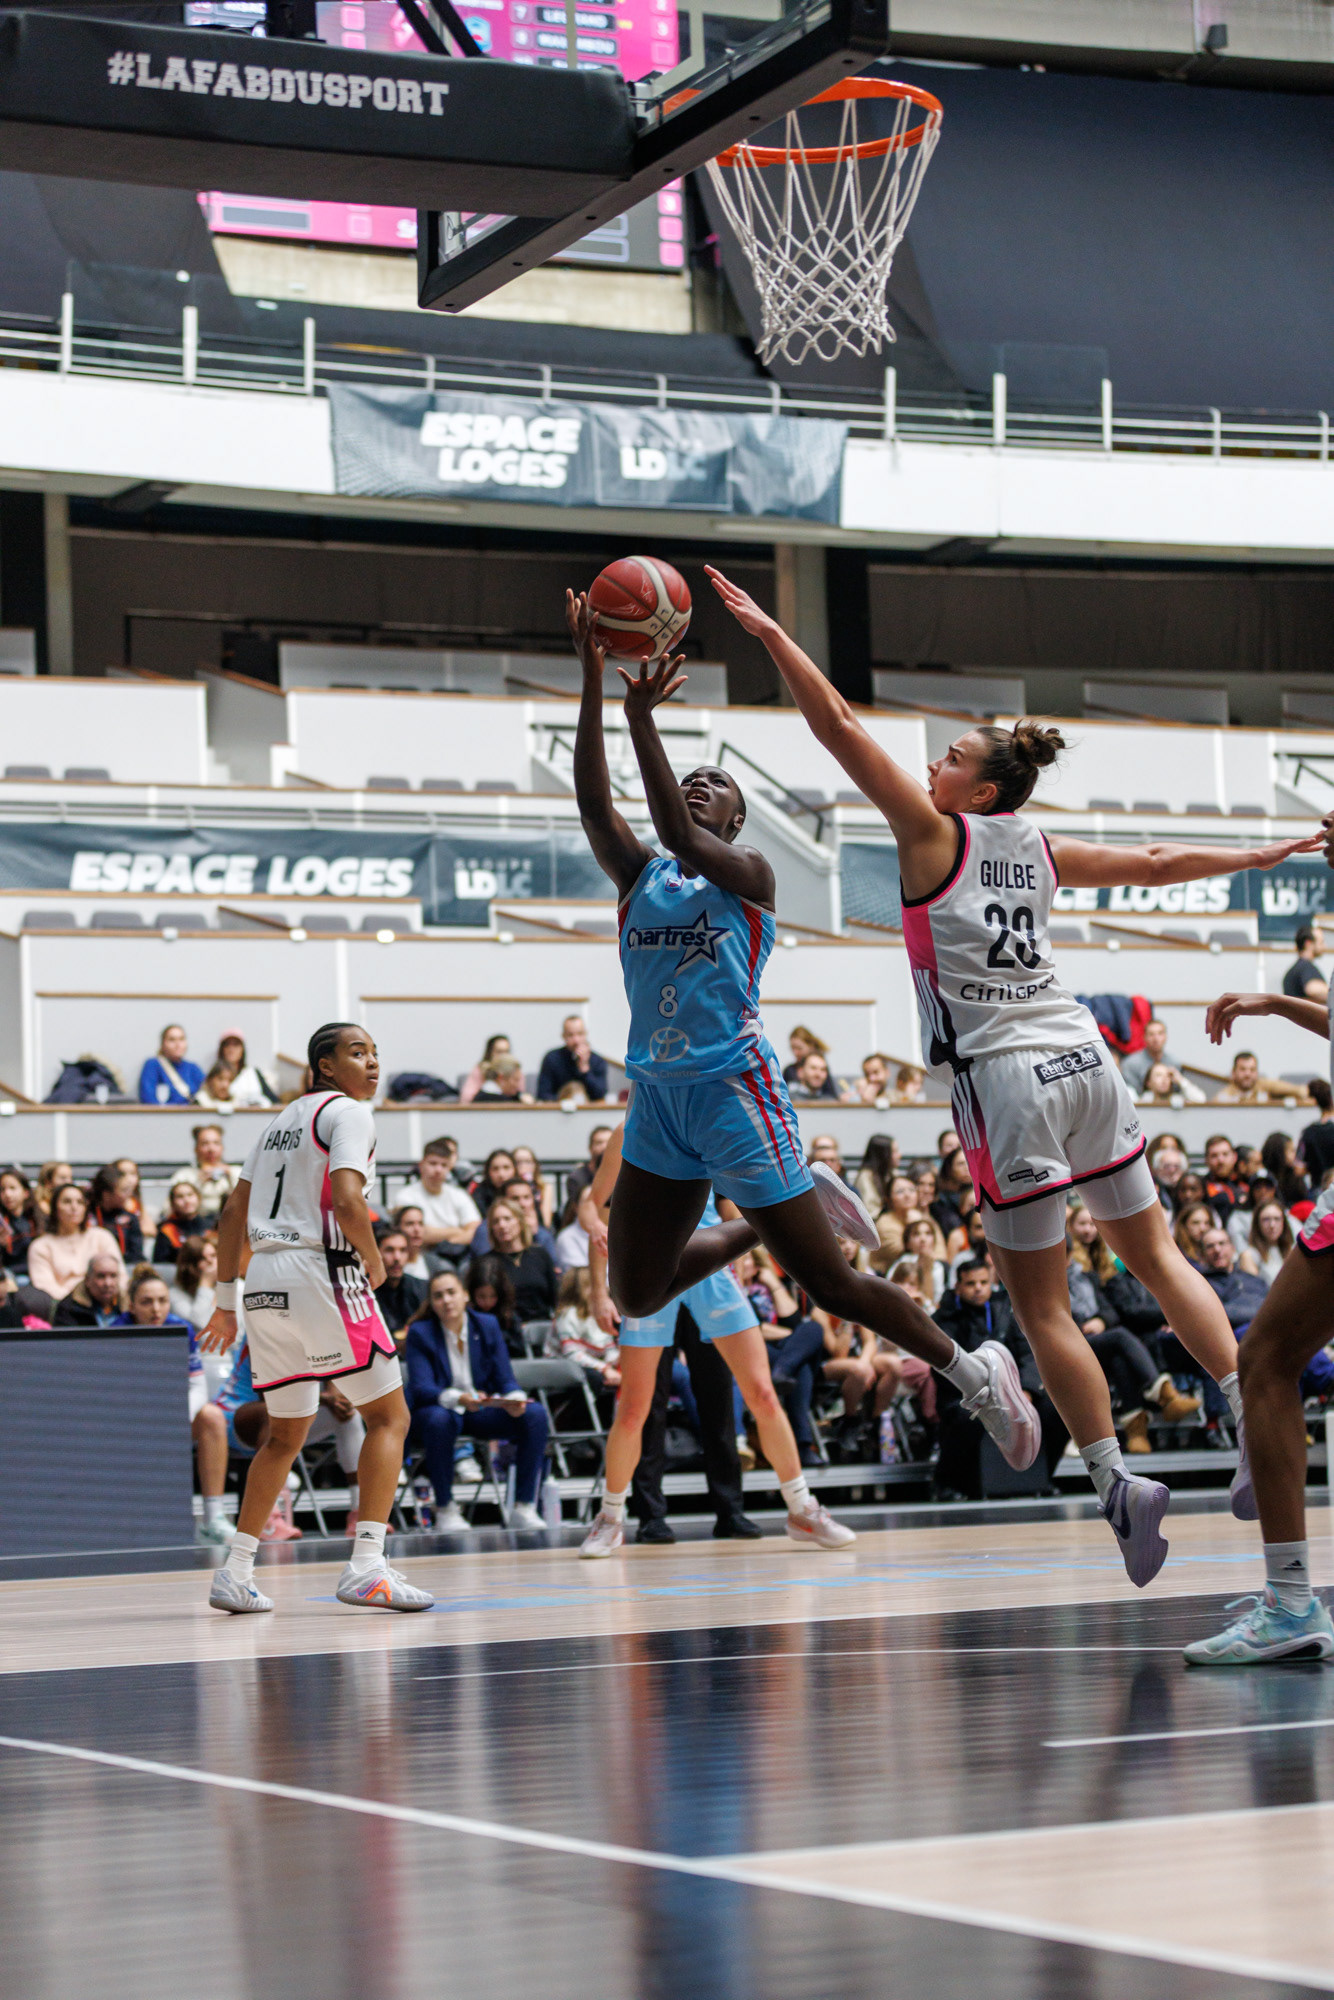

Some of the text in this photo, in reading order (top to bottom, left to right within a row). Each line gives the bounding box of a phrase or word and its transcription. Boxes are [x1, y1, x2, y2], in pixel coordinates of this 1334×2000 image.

[107, 51, 449, 116] #LAFABDUSPORT
[420, 411, 582, 454] ESPACE
[438, 448, 569, 488] LOGES
[69, 852, 415, 898] ESPACE LOGES
[455, 869, 532, 899] LDLC
[981, 860, 1036, 890] GULBE
[1108, 877, 1231, 913] LOGES
[1262, 887, 1326, 916] LDLC
[627, 926, 707, 949] Chartres
[984, 903, 1041, 969] 23
[658, 984, 678, 1018] 8
[1072, 1051, 1096, 1068] CAR
[269, 1164, 286, 1219] 1
[269, 1296, 285, 1306] CAR
[312, 1352, 342, 1362] Extenso
